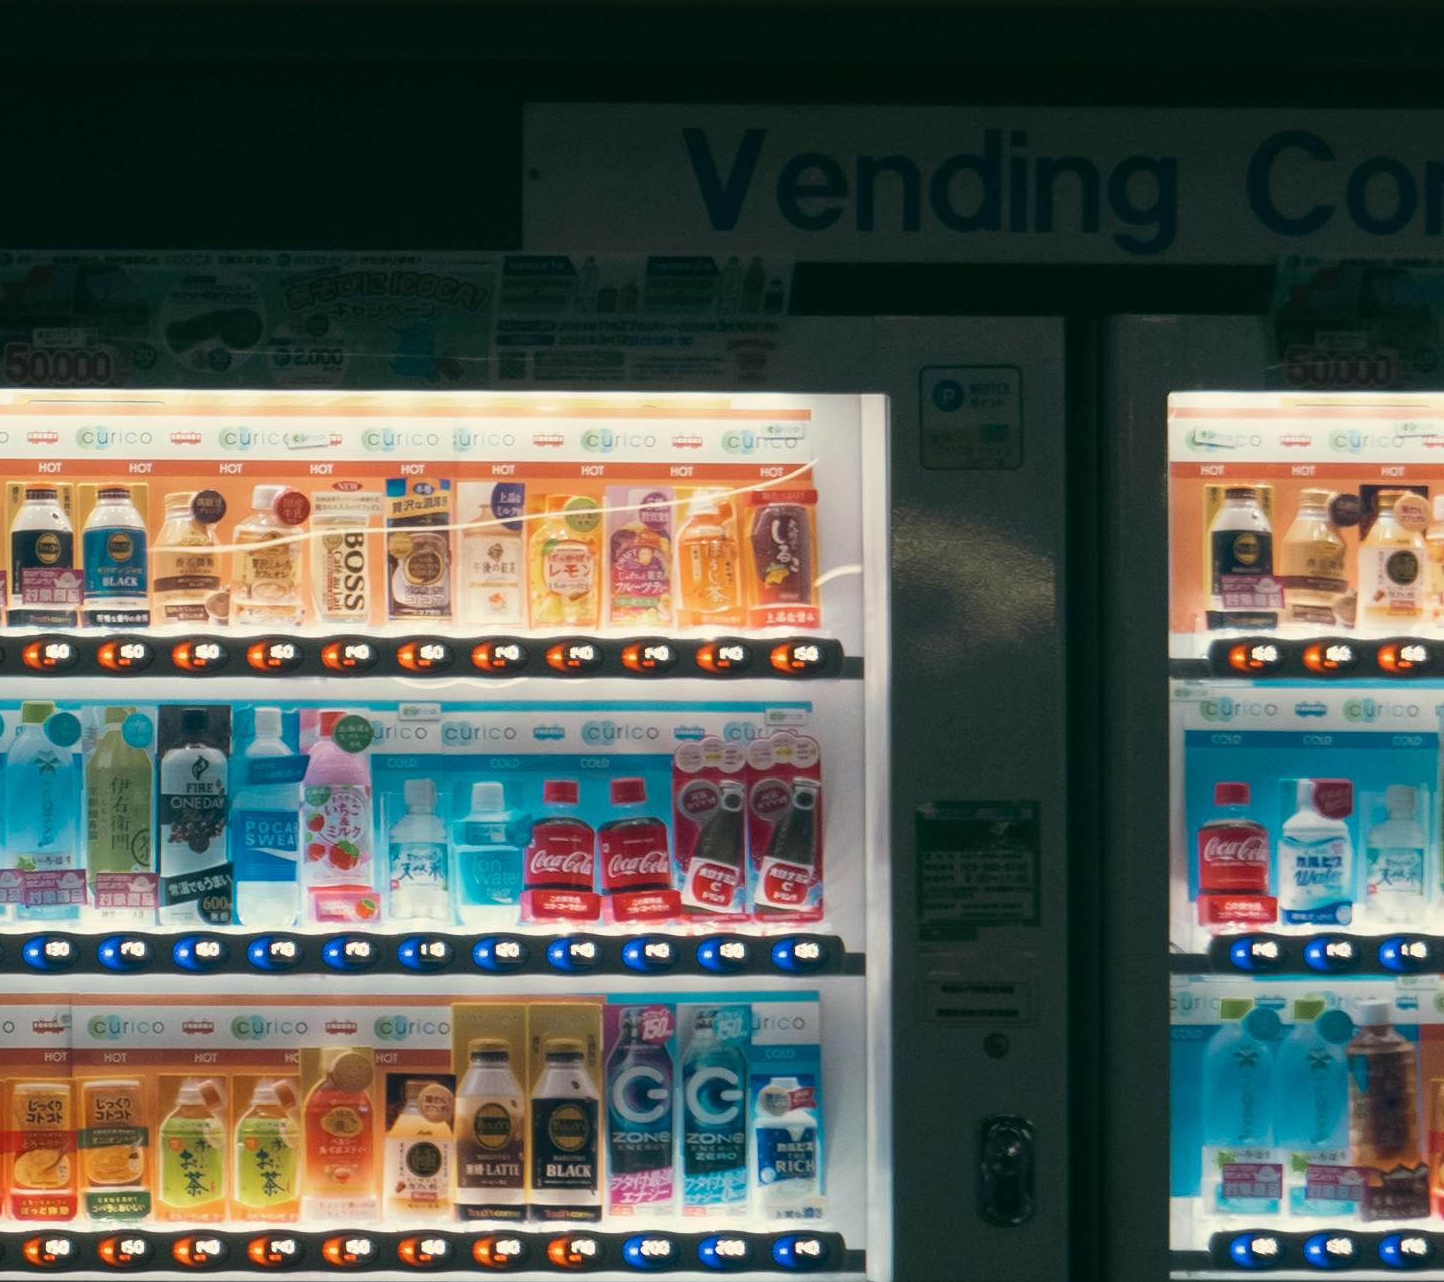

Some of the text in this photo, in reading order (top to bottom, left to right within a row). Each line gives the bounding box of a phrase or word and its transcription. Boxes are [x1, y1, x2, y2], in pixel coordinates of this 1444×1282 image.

[681, 127, 1179, 256] Vending
[328, 297, 447, 321] キャンペーン
[3, 341, 111, 385] 50,000
[291, 345, 344, 368] 2,000
[81, 428, 153, 446] curico
[587, 432, 657, 450] curico
[220, 462, 243, 475] HOT
[492, 464, 516, 476] HOT
[760, 466, 785, 478] HOT
[1292, 465, 1316, 477] HOT
[338, 482, 358, 491] NEW
[343, 532, 366, 611] BOSS
[473, 561, 516, 575] 午後の紅茶
[548, 563, 591, 579] レモン
[102, 576, 139, 587] BLACK
[444, 722, 517, 742] curico
[1302, 735, 1333, 747] COLD
[386, 757, 417, 770] COLD
[186, 782, 214, 793] FIRE
[170, 796, 225, 810] ONEDAY
[324, 803, 361, 817] いちご
[110, 777, 132, 851] 伊右衛門
[327, 826, 362, 838] ミルク
[529, 849, 595, 875] Coca-Cola
[607, 852, 669, 877] Coca-Cola
[1295, 855, 1343, 866] カルピス
[168, 874, 233, 897] 常温でもうまい
[711, 883, 722, 893] C
[781, 883, 792, 893] C
[94, 1018, 165, 1036] curico
[380, 1019, 452, 1038] curico
[194, 1052, 218, 1064] HOT
[764, 1049, 796, 1059] COLD
[28, 1099, 63, 1113] じっくり
[26, 1111, 63, 1124] コトコト
[618, 1143, 667, 1151] ENERGY
[691, 1143, 742, 1151] ENERGY
[695, 1152, 737, 1161] ZERO
[486, 1163, 520, 1177] LATTE
[545, 1164, 591, 1179] BLACK
[775, 1160, 814, 1174] RICH
